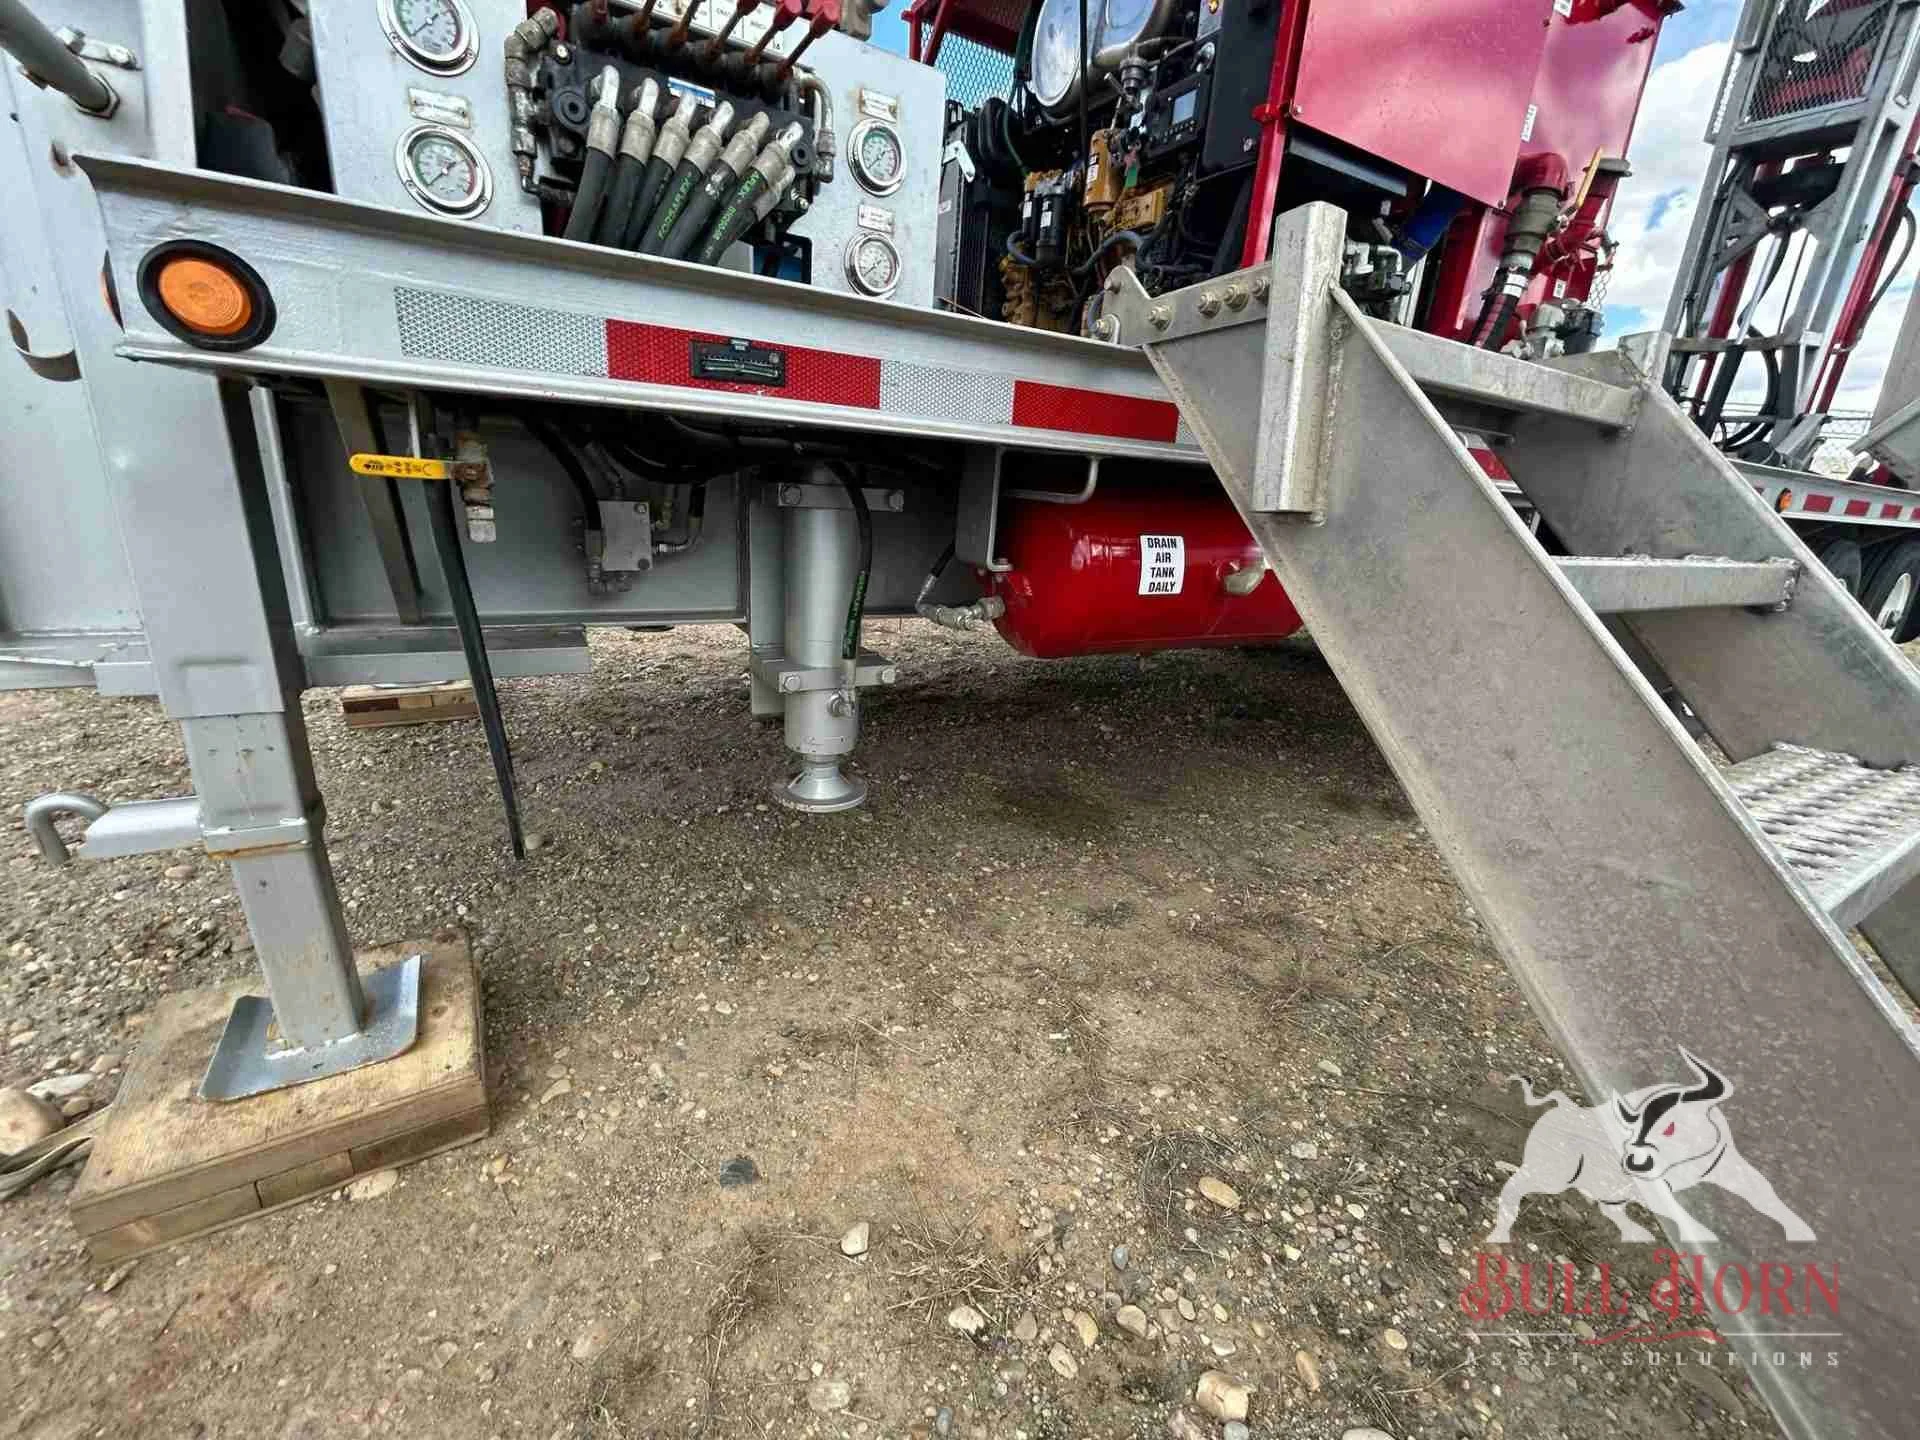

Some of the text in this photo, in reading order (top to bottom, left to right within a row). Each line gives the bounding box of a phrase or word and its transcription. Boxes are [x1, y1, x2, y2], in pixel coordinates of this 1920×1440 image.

[1147, 537, 1177, 549] DRAIN
[1155, 552, 1172, 563] AIR
[1150, 566, 1176, 578] TANK
[1148, 581, 1176, 593] DAILY
